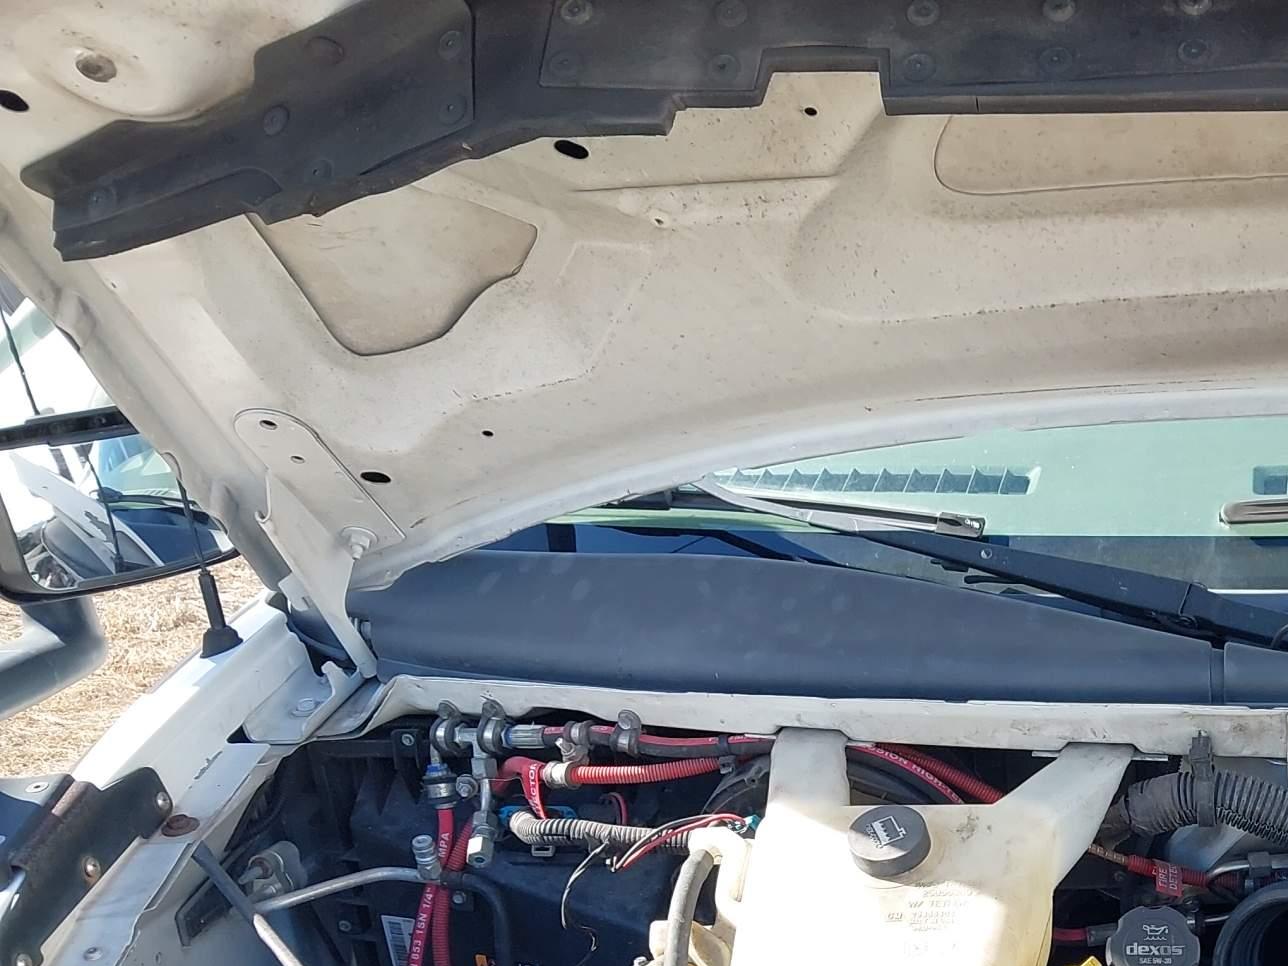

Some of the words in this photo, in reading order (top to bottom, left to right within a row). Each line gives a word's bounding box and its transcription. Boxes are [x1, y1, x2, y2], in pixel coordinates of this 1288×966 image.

[438, 832, 450, 858] MPA
[1158, 867, 1168, 888] FIRE
[415, 912, 428, 935] 1SN
[1126, 943, 1185, 956] dexos
